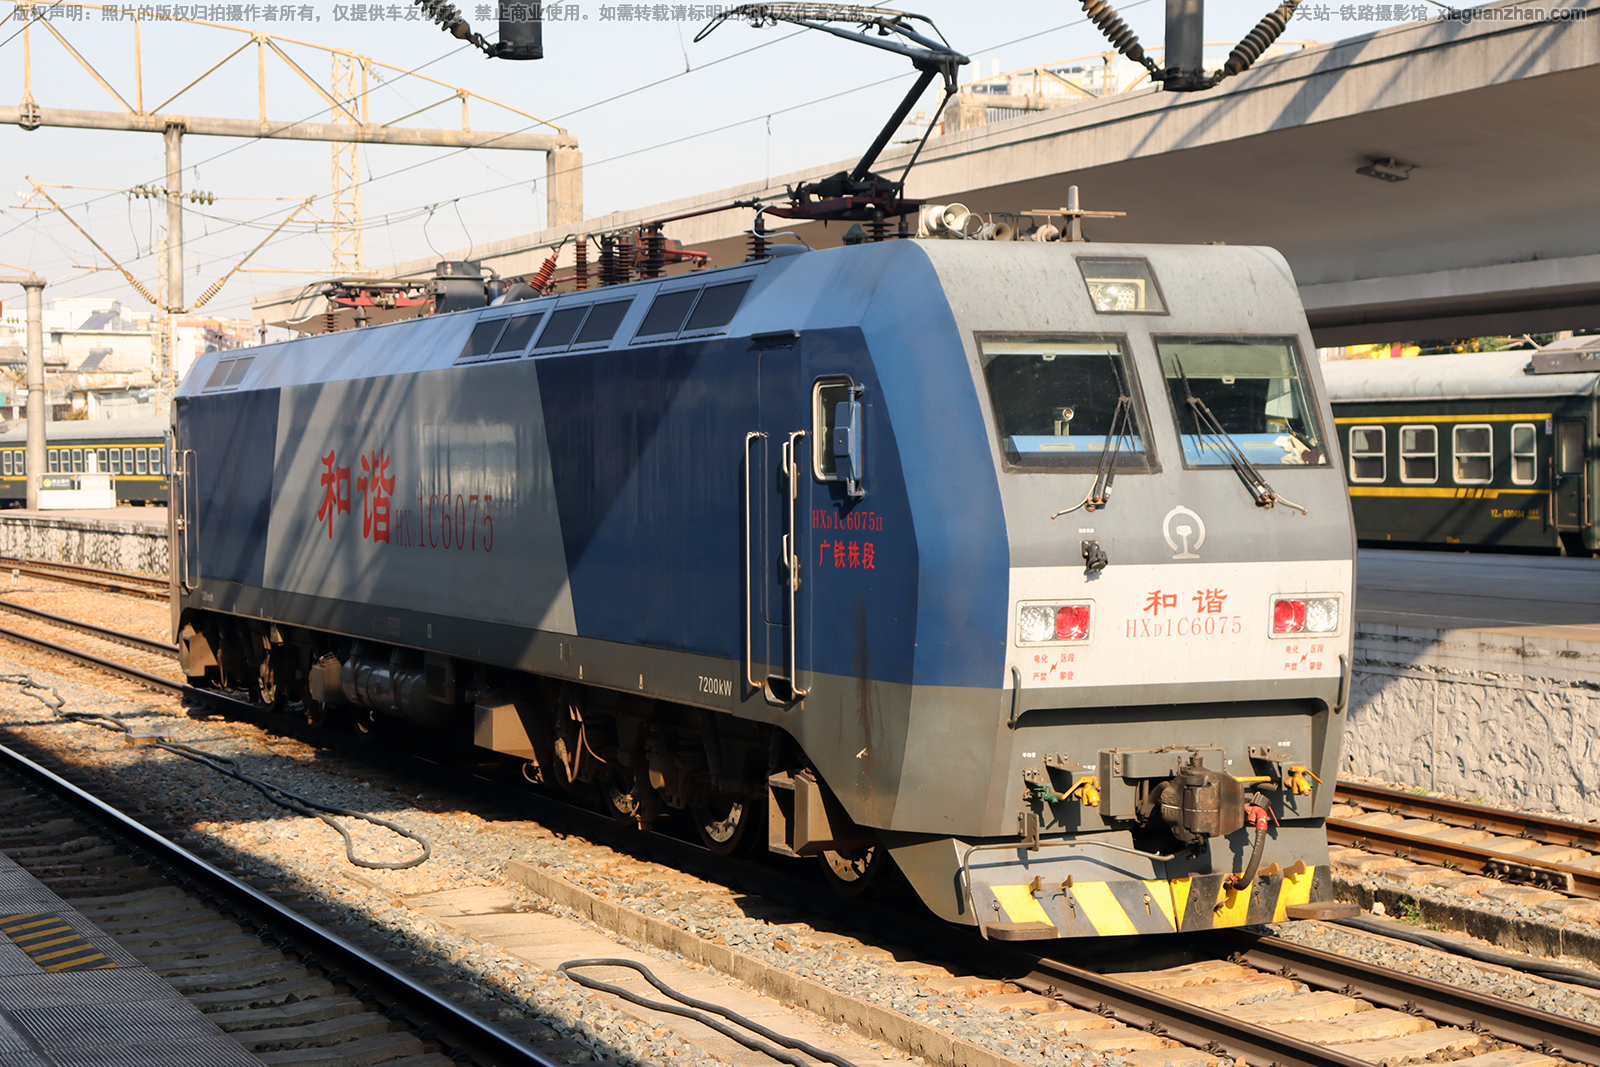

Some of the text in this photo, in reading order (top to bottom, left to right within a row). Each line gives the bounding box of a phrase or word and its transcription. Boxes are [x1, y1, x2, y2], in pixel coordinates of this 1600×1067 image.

[317, 448, 396, 545] 和谐
[818, 539, 876, 570] 广铁株段
[1142, 587, 1229, 616] 和谐
[698, 675, 733, 697] 7200kW
